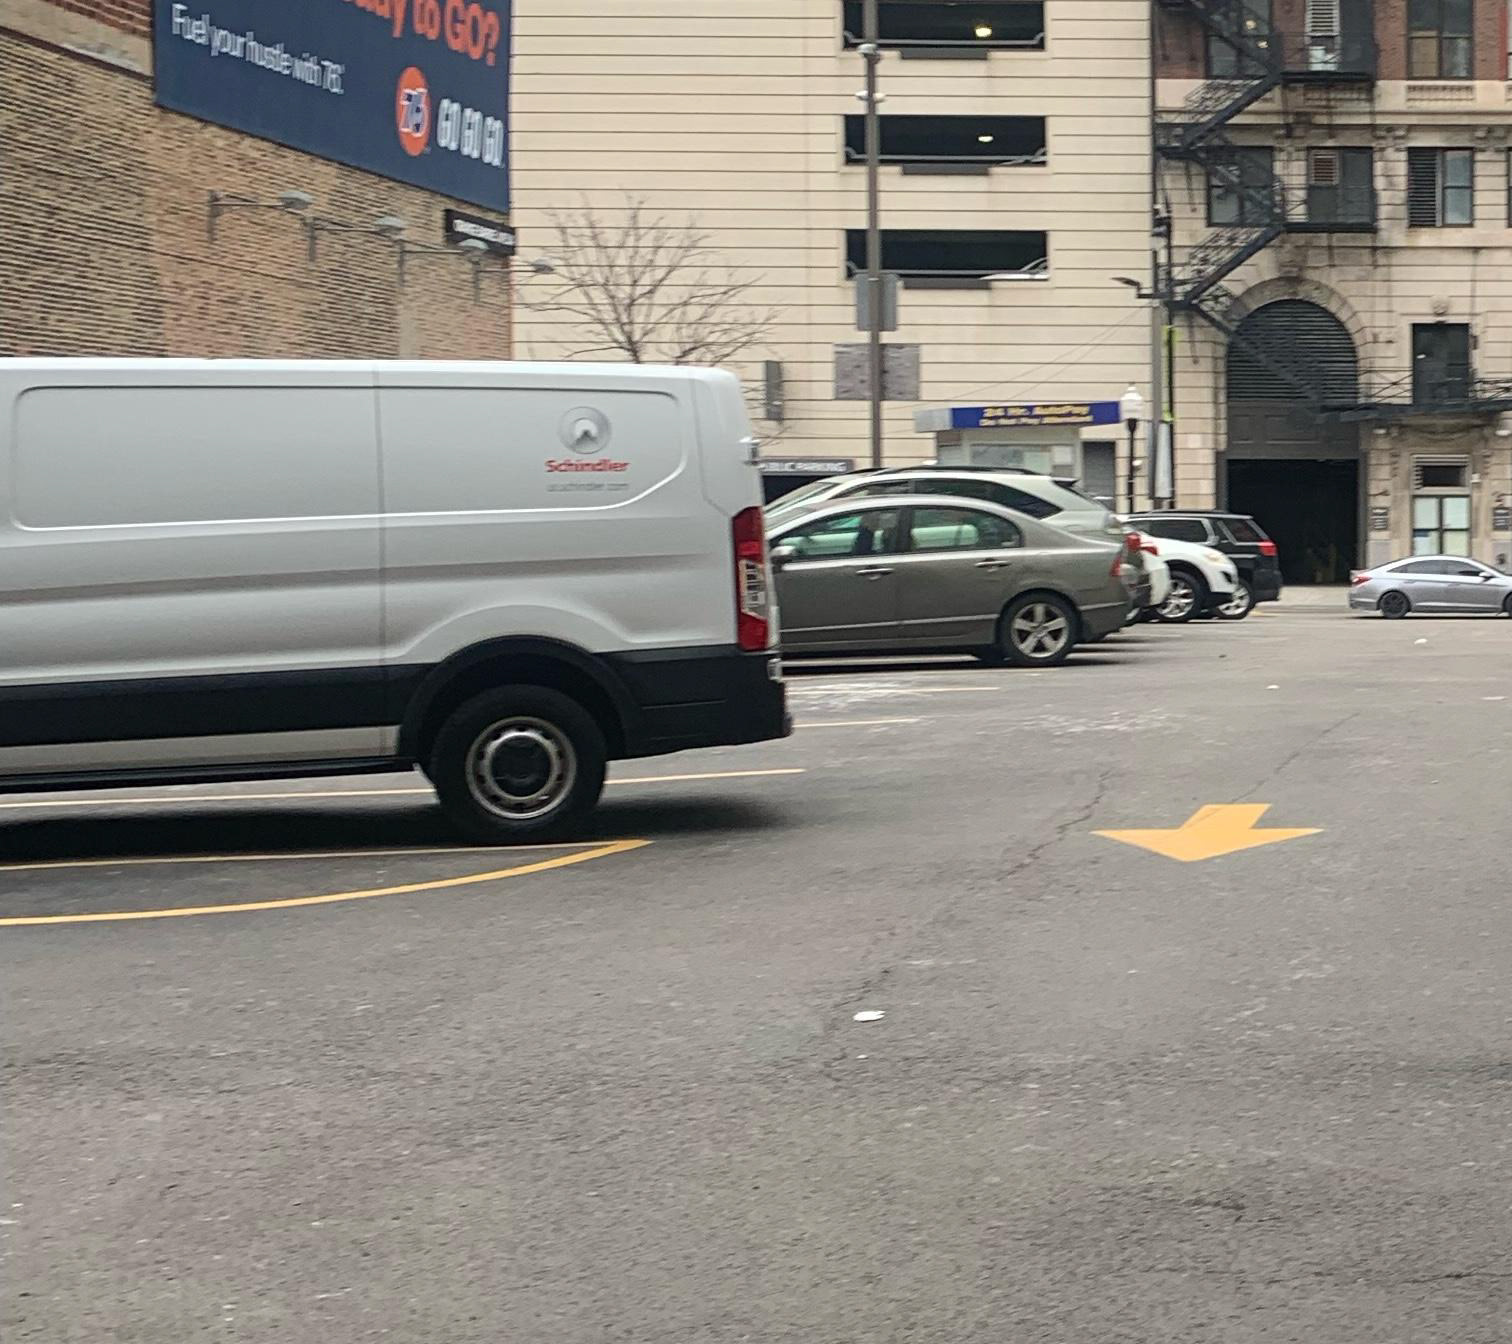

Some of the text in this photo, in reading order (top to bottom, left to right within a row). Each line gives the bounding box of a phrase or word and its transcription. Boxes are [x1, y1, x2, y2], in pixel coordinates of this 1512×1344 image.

[172, 3, 210, 46] Fuel
[209, 25, 245, 57] your
[245, 31, 292, 75] hustle
[291, 52, 322, 87] with
[544, 459, 631, 472] Schindler
